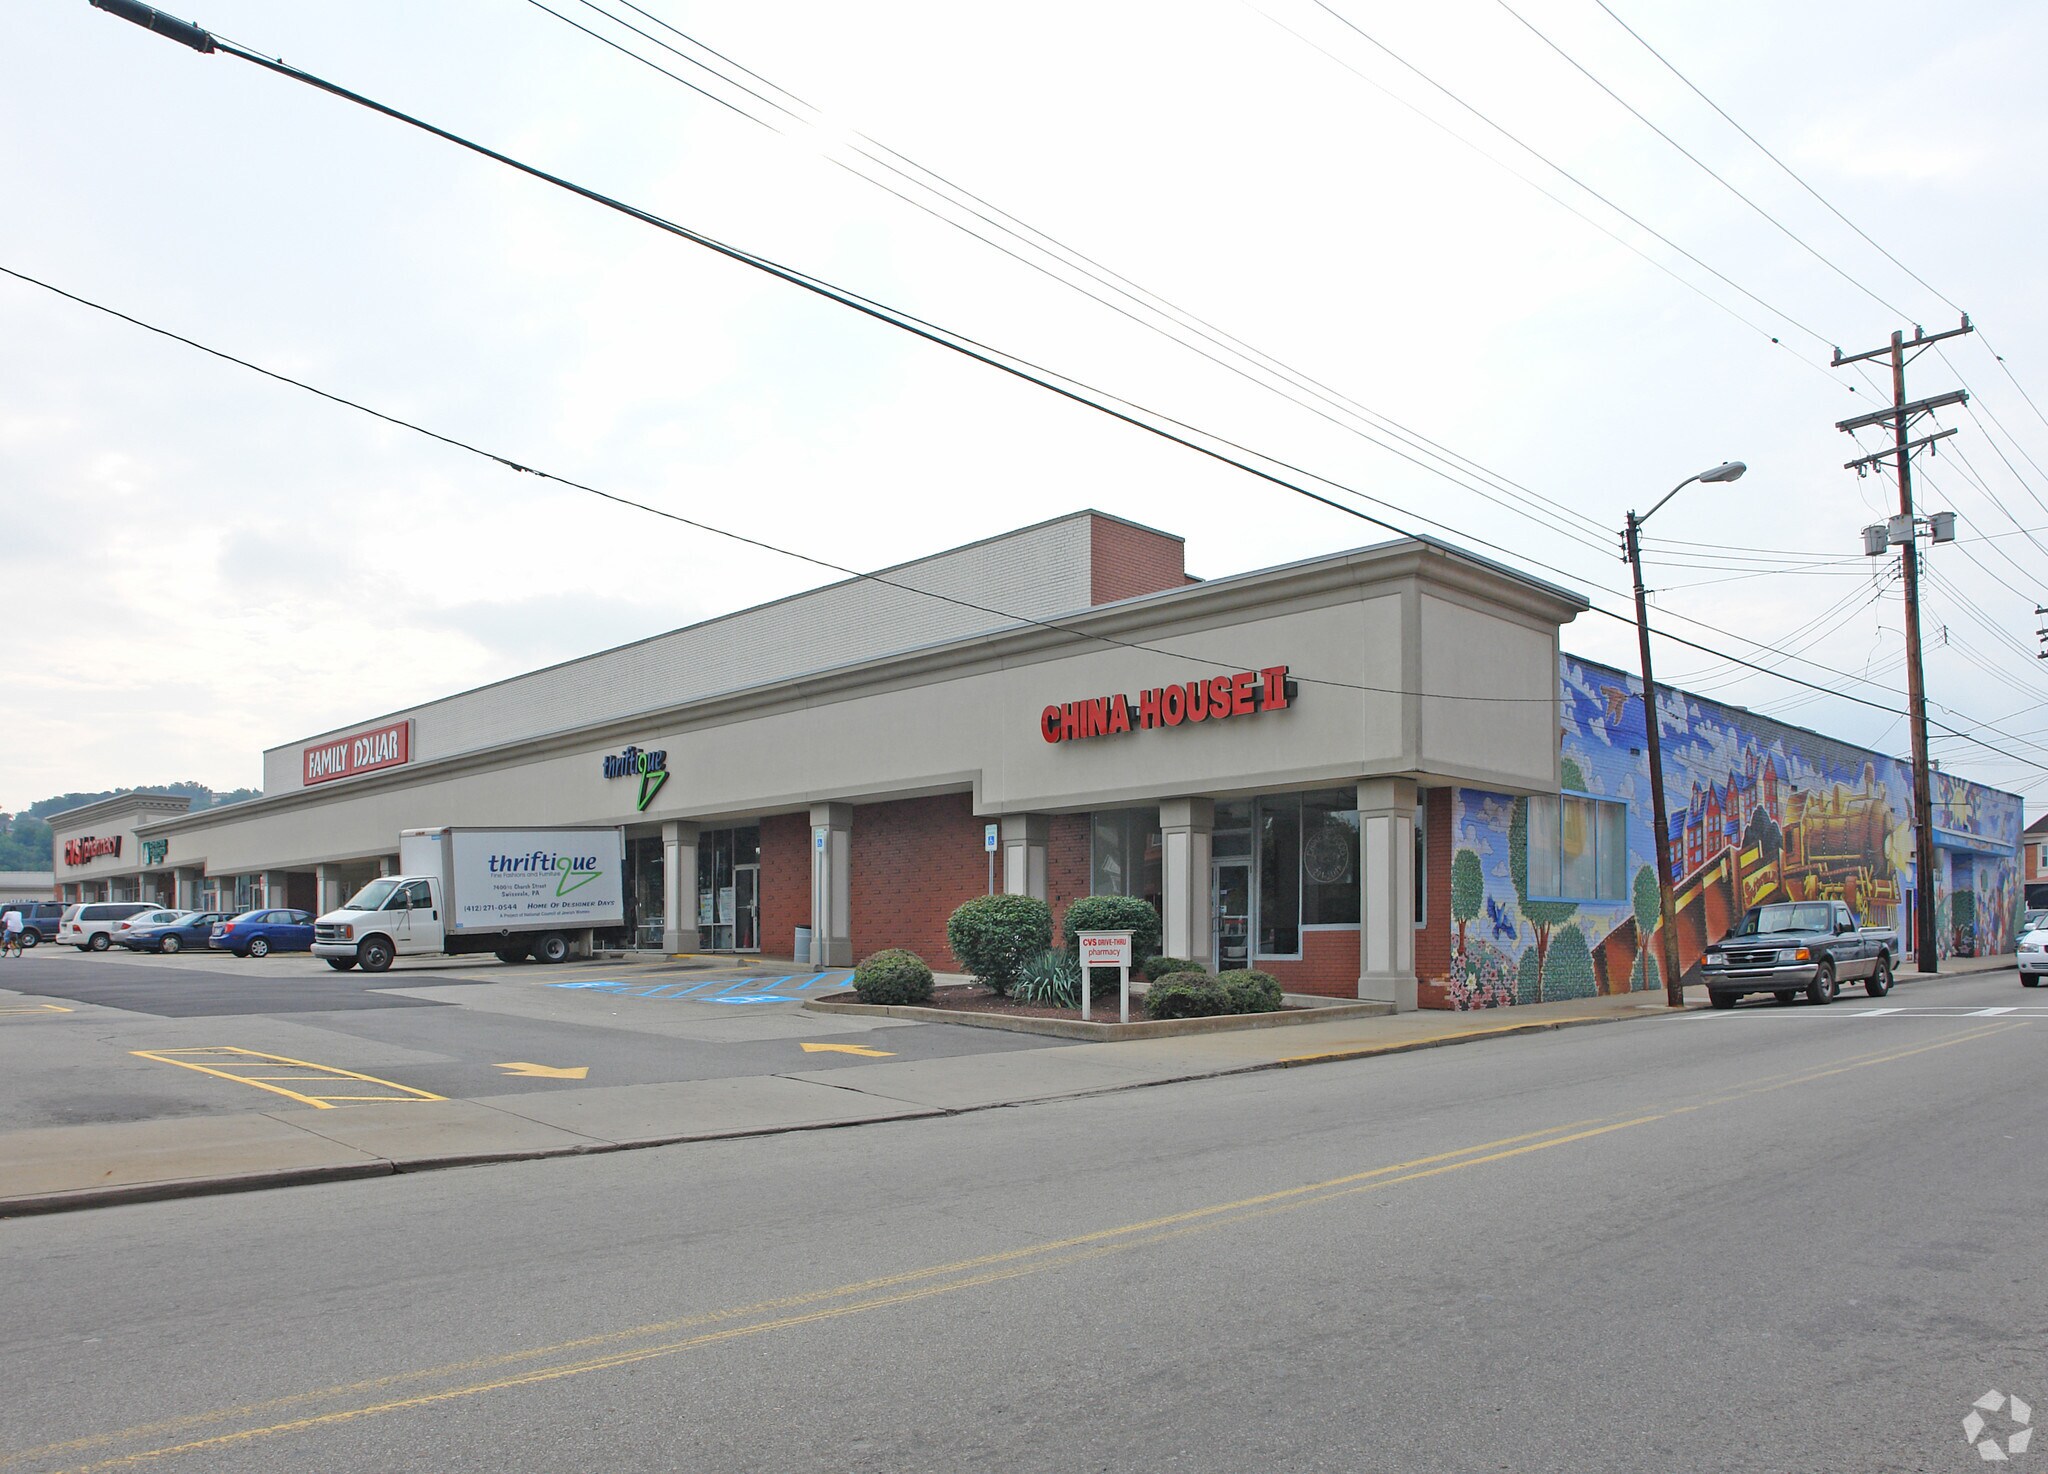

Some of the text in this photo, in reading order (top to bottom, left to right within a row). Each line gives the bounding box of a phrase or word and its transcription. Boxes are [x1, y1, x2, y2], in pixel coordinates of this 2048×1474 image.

[1041, 665, 1289, 743] CHINA HOUSE II
[308, 730, 398, 779] FAMILY DOLLAR
[602, 746, 669, 811] thriftique
[488, 850, 602, 898] thriftique
[1082, 938, 1097, 947] CVS
[1088, 948, 1121, 957] pharmacy
